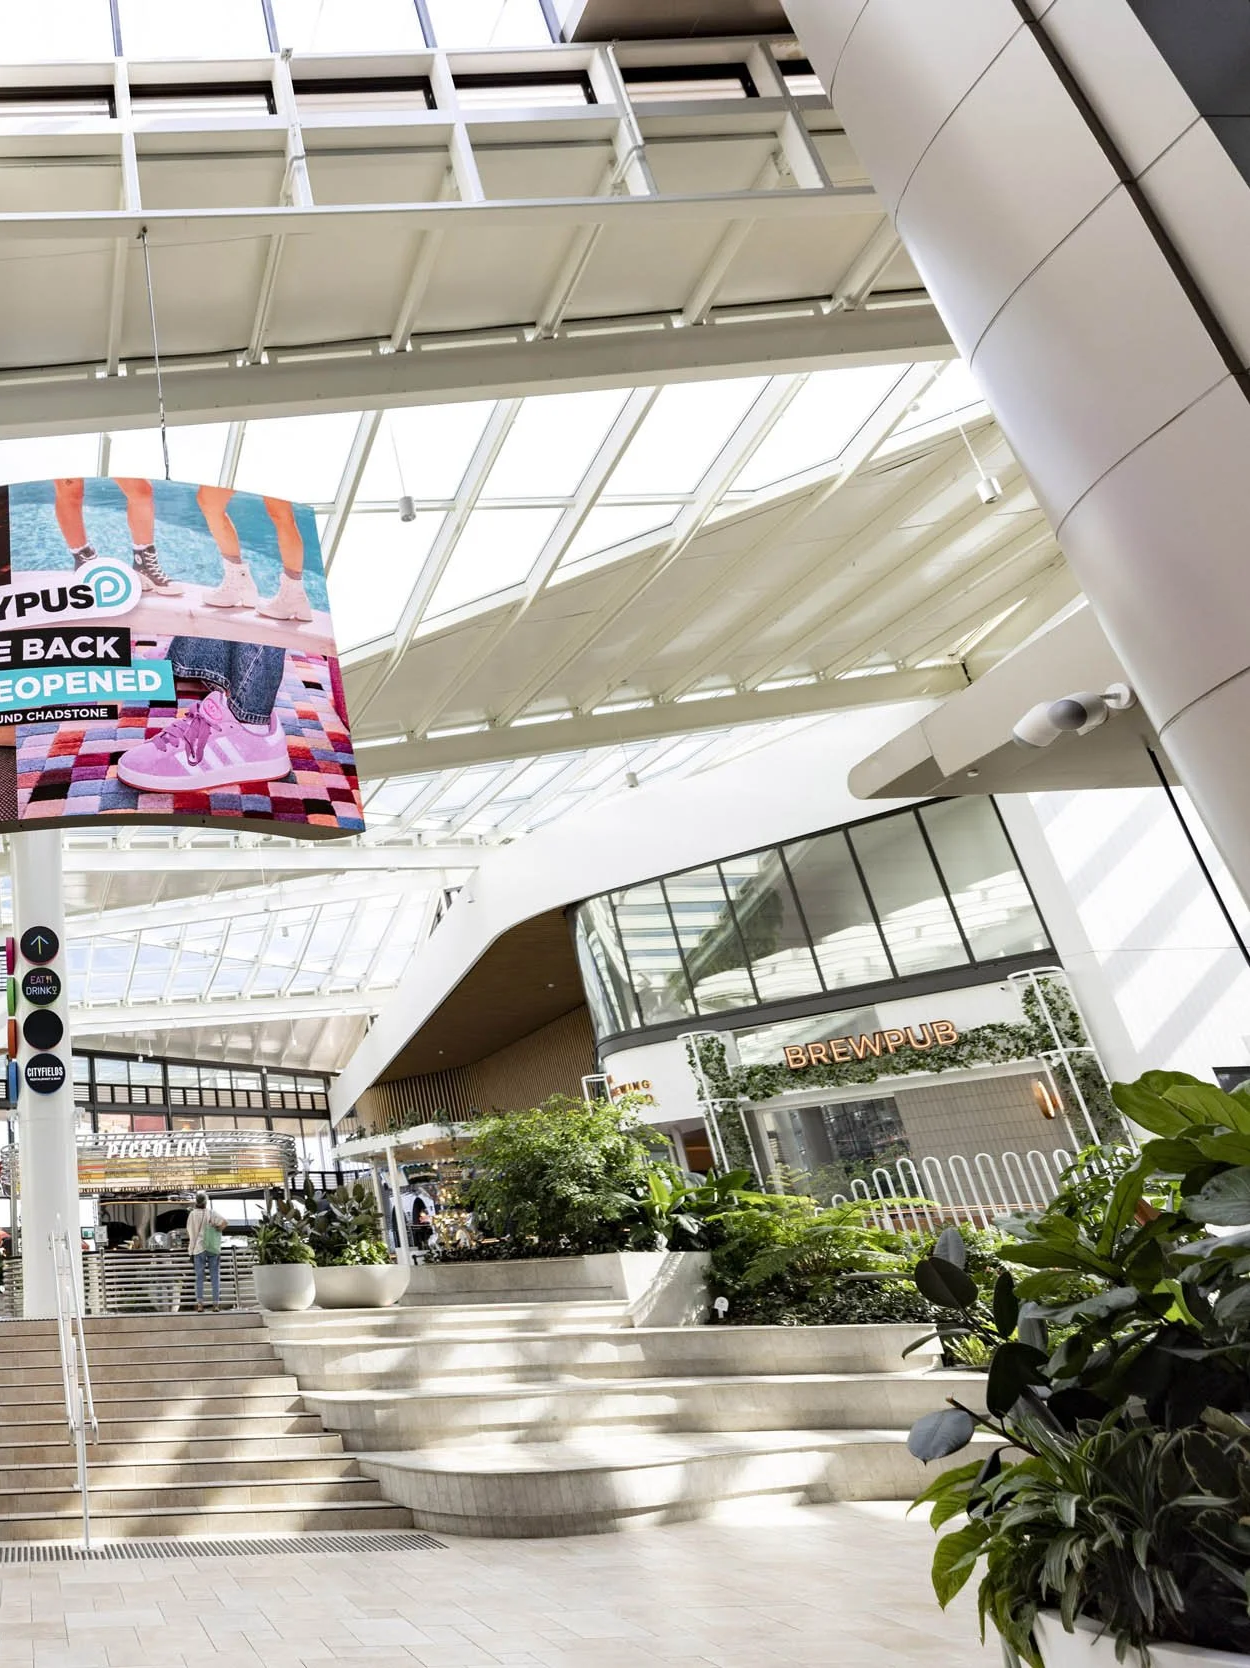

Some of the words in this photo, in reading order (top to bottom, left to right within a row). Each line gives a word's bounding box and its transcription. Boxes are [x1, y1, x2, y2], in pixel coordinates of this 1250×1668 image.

[22, 636, 120, 661] BACK
[26, 708, 108, 722] CHADSTONE
[30, 975, 45, 984] EAT
[25, 986, 52, 995] DRINK
[783, 1020, 959, 1070] BREWPUB
[27, 1066, 63, 1077] CITYFIELDS
[106, 1139, 210, 1159] PICCOLINA
